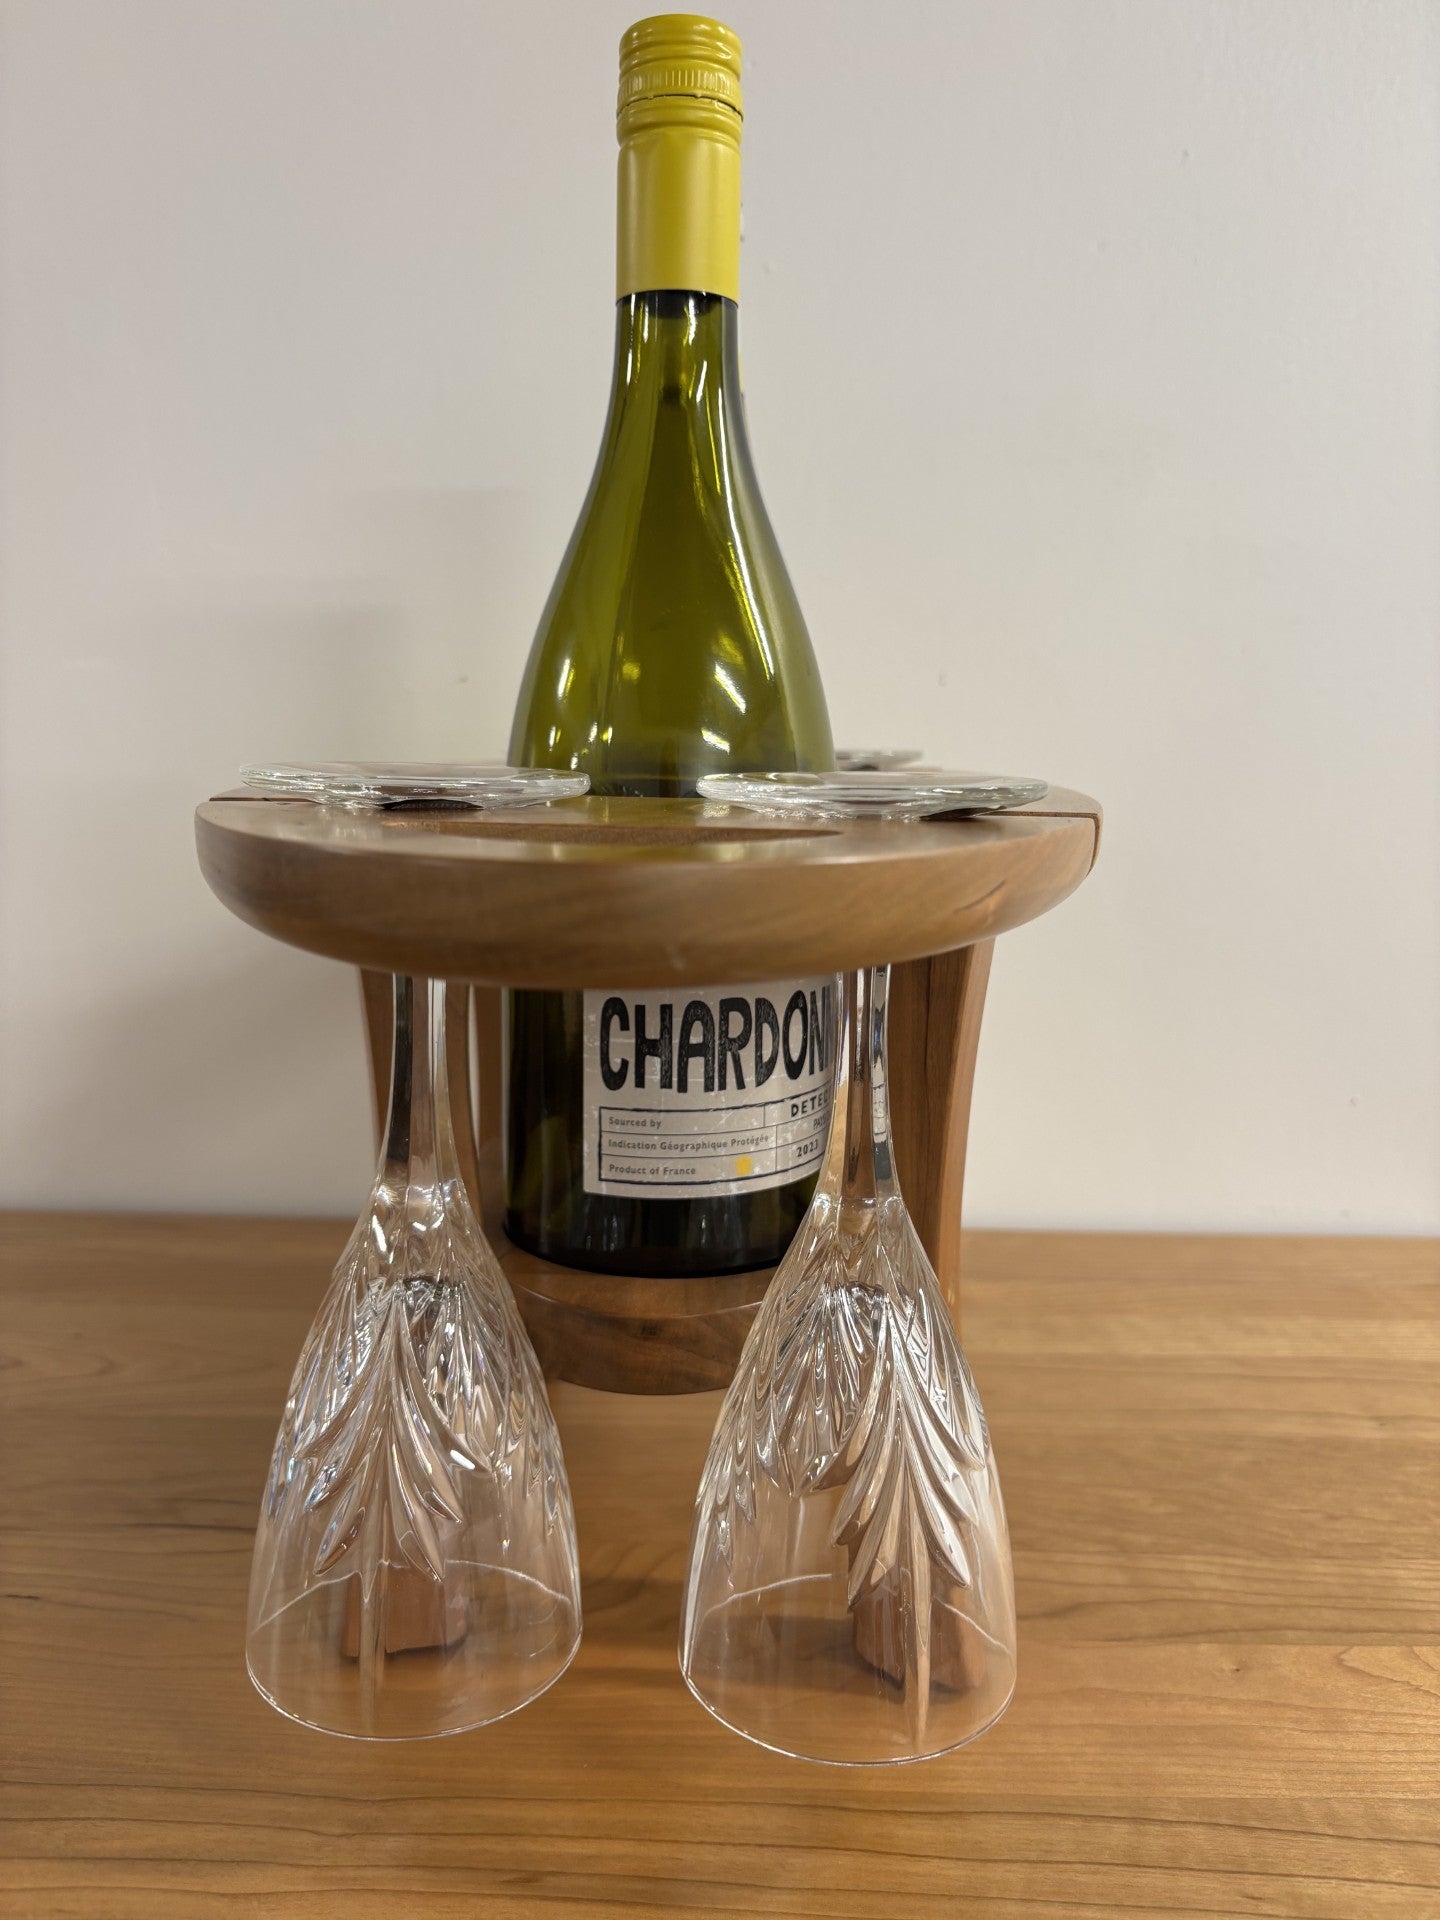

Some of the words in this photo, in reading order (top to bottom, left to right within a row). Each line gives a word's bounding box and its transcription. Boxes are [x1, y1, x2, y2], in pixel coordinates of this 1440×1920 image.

[608, 1116, 647, 1127] Sourced
[650, 1116, 662, 1129] by
[608, 1139, 657, 1150] Indication
[660, 1140, 728, 1152] Géographique
[730, 1134, 769, 1148] Protégée
[609, 1163, 647, 1175] Product
[649, 1165, 661, 1175] of
[662, 1165, 697, 1175] France
